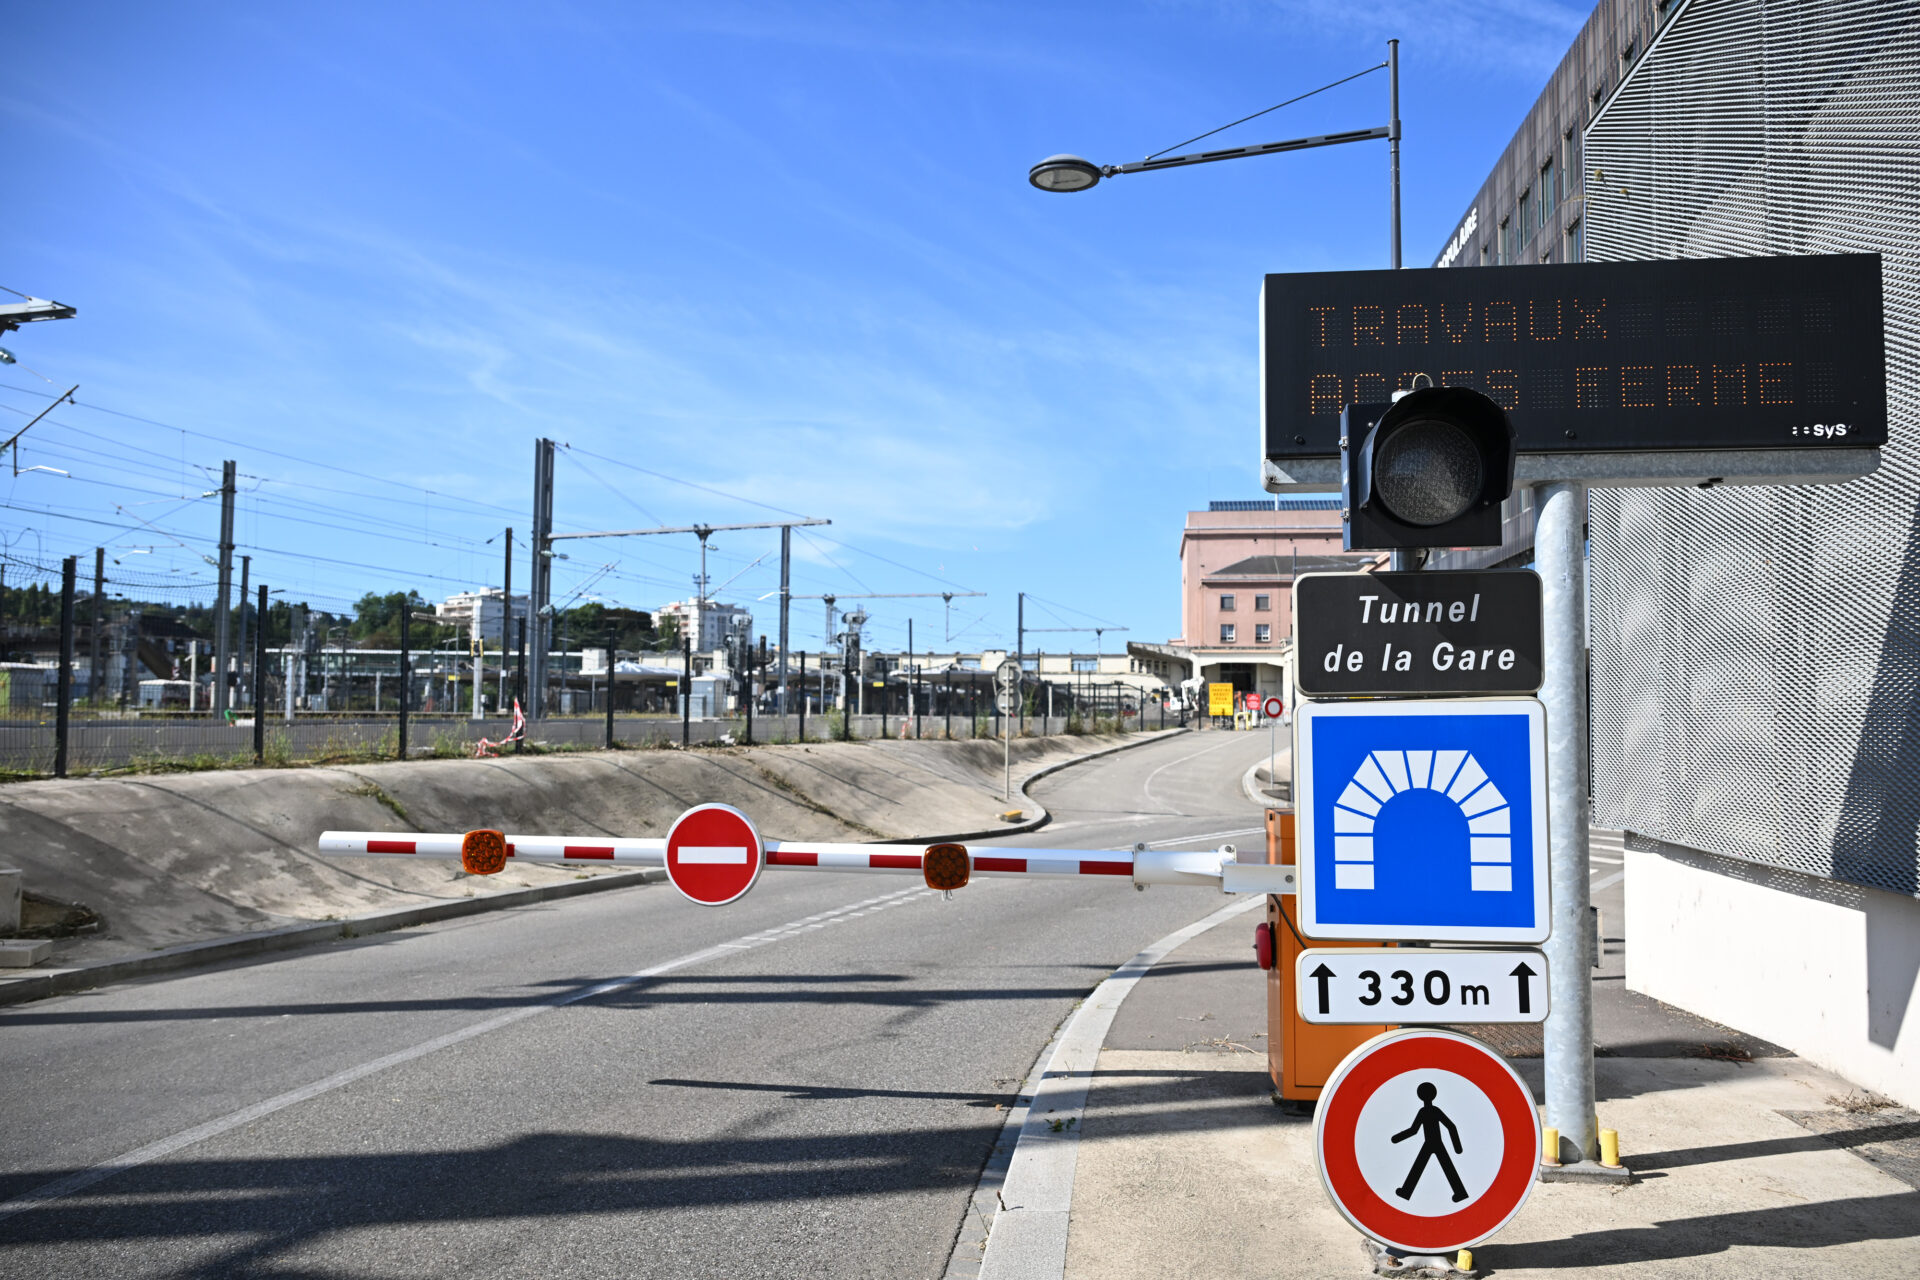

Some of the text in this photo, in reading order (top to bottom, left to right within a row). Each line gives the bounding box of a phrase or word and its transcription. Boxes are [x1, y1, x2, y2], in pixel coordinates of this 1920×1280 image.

[1310, 298, 1607, 347] TRAVAUX
[1576, 362, 1793, 408] FERME
[1358, 593, 1480, 624] Tunnel
[1323, 642, 1516, 673] de la Gare
